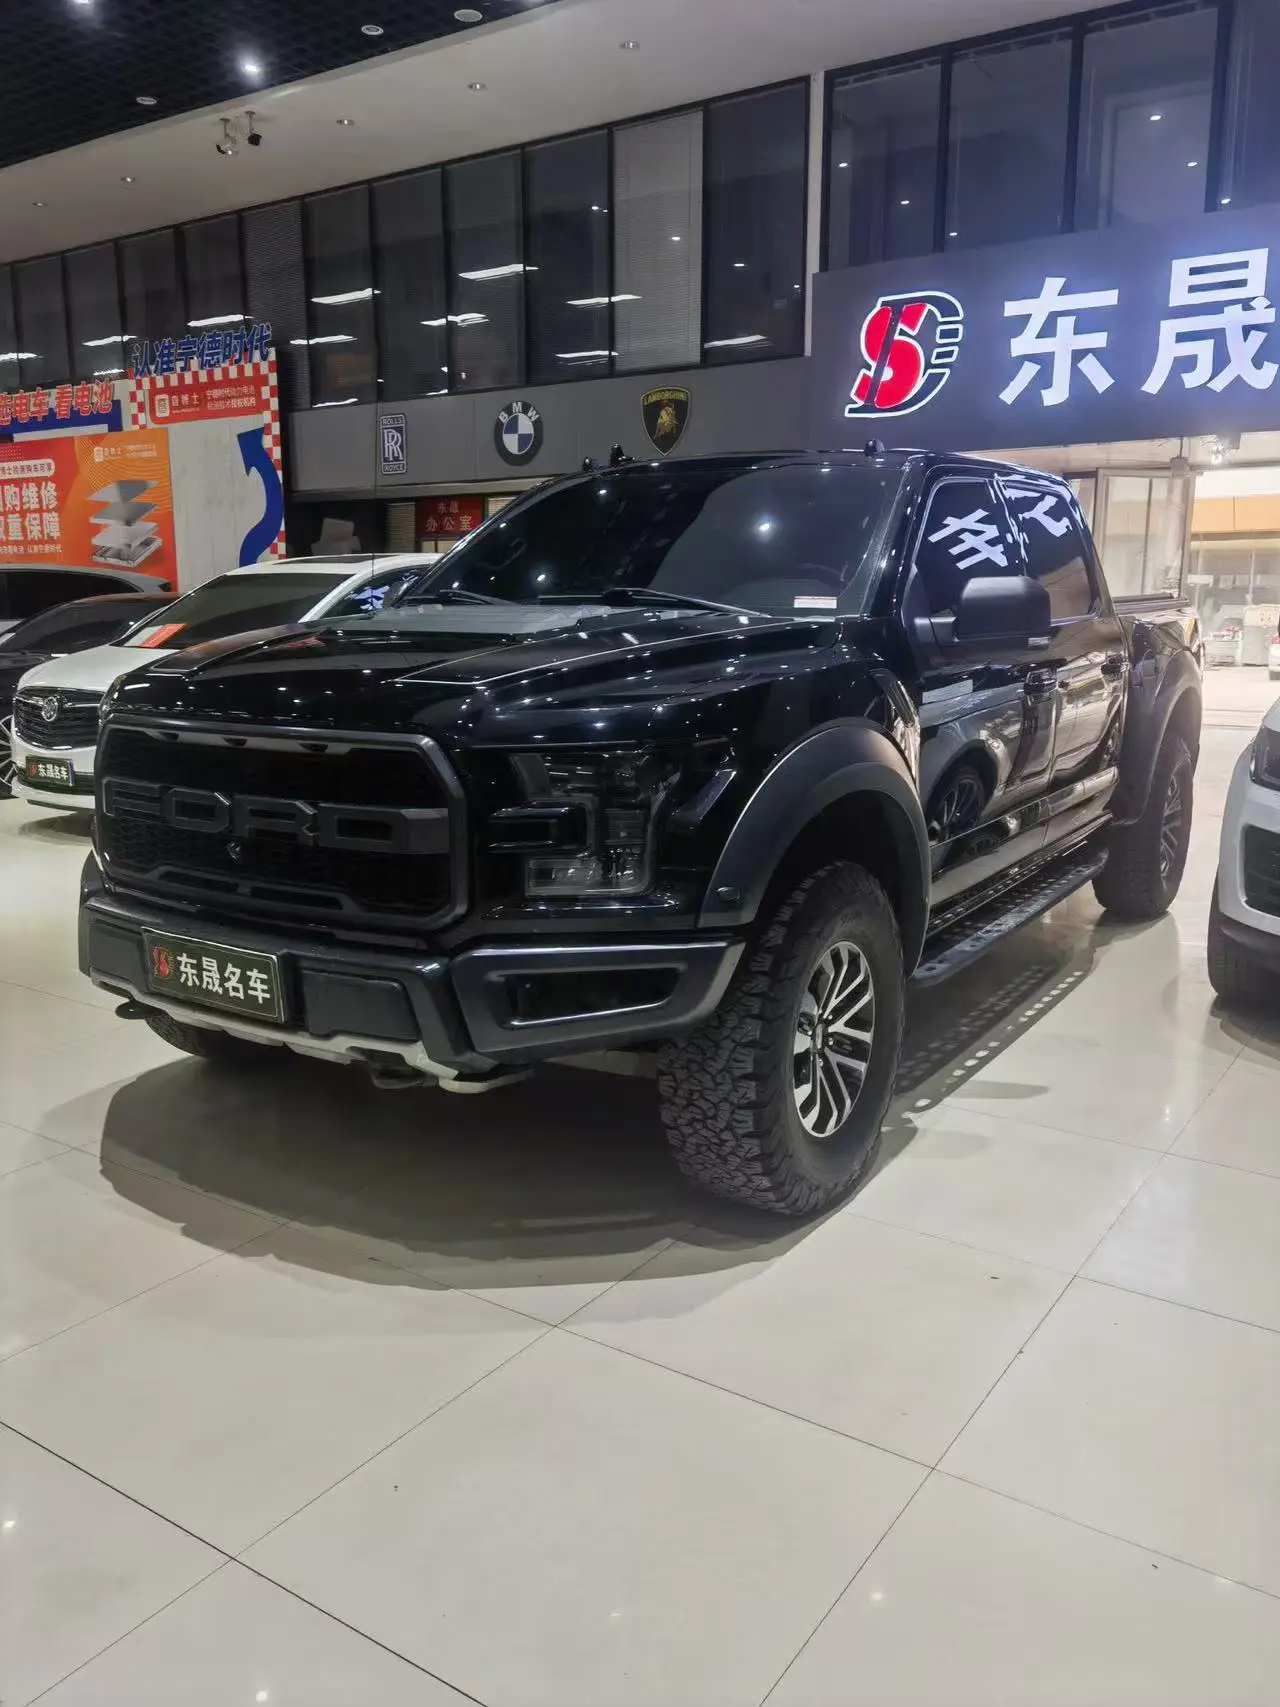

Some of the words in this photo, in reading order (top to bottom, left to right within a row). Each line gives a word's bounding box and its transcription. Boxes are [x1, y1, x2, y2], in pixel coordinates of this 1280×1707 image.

[999, 248, 1279, 406] 东晟
[132, 323, 272, 378] 认准宁德时代
[644, 390, 687, 405] LAMBORGHINI
[382, 416, 402, 425] ROLLS
[498, 401, 540, 423] BMW
[384, 463, 404, 472] ROYCE
[0, 481, 57, 512] 购维修
[424, 514, 472, 532] 办公室
[38, 764, 68, 780] 东晟名车
[101, 776, 449, 854] FORD
[176, 952, 271, 1004] 东晟名车
